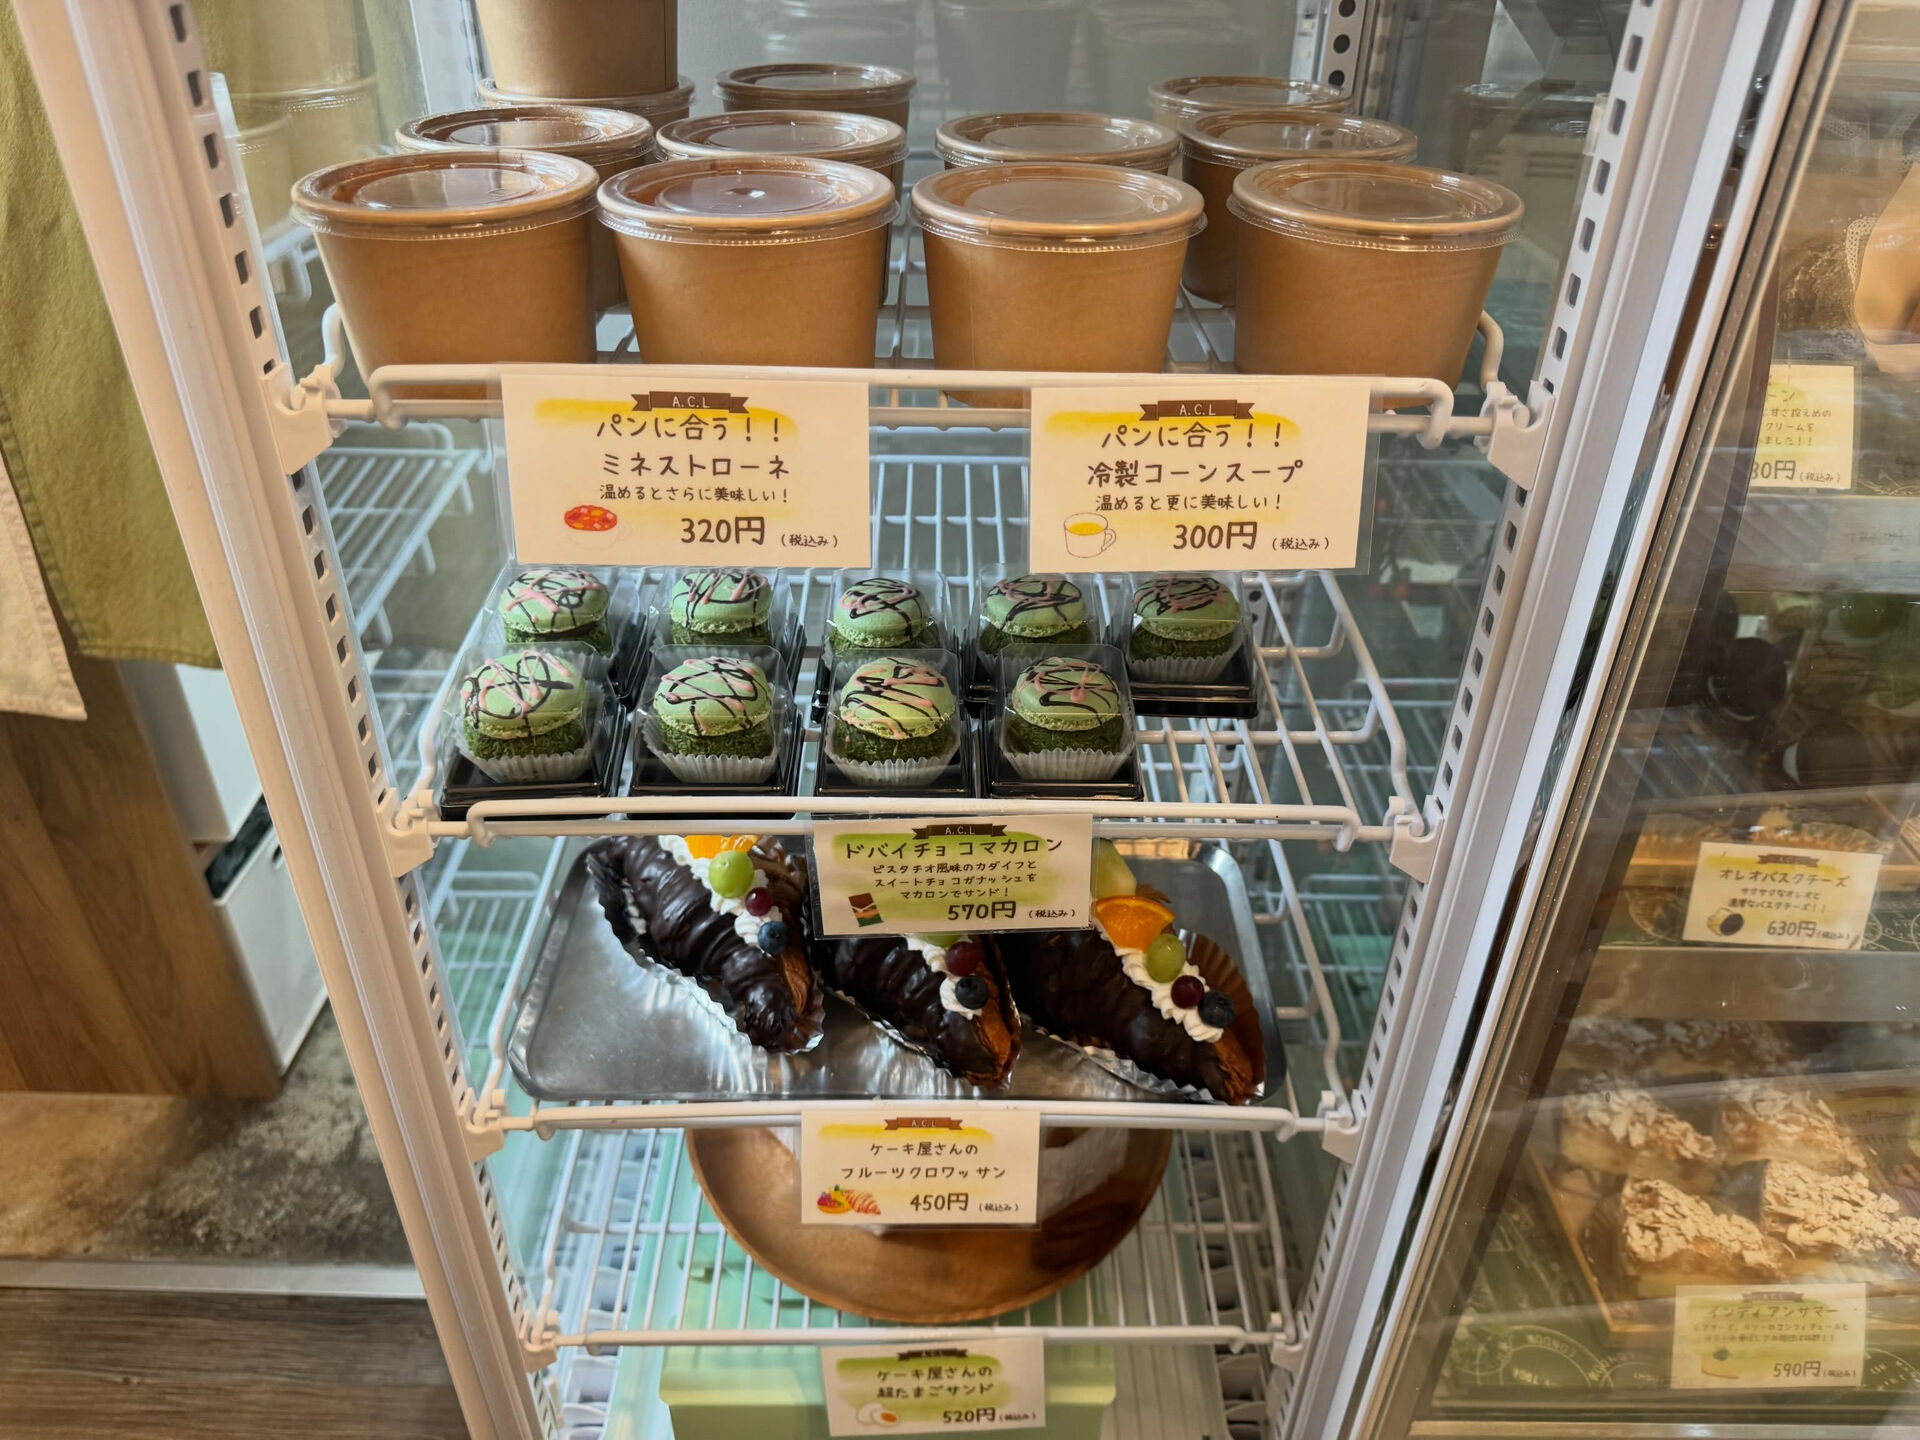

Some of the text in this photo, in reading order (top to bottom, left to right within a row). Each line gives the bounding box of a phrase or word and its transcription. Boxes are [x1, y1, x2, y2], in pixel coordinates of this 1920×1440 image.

[672, 396, 711, 409] A.C.L
[1179, 403, 1217, 417] A.C.L
[602, 452, 790, 479] ミネストローネ
[1087, 459, 1304, 488] 冷製コーンスープ
[600, 484, 789, 504] 温めるとさらに美味しい！
[1095, 494, 1282, 512] 温めると更に美味しい！
[681, 516, 766, 546] 320円
[1173, 521, 1258, 551] 300円
[944, 825, 976, 836] A.C.L
[845, 838, 1063, 860] ドバイチョコマカロン
[872, 860, 1037, 875] ピスタチオ風味のカダイフと
[874, 873, 1037, 888] スイートチョコガナッシュを
[1719, 868, 1851, 888] オレオバスクチーズ
[947, 900, 1017, 921] 570円
[1767, 920, 1818, 937] 630円
[870, 1141, 979, 1156] ケーキ屋さんの
[840, 1166, 1007, 1180] フルーツクロワッサン
[909, 1192, 970, 1212] 450円
[877, 1366, 993, 1383] ケーキ屋さんの
[1773, 1360, 1822, 1378] 590円
[943, 1407, 996, 1424] 520円
